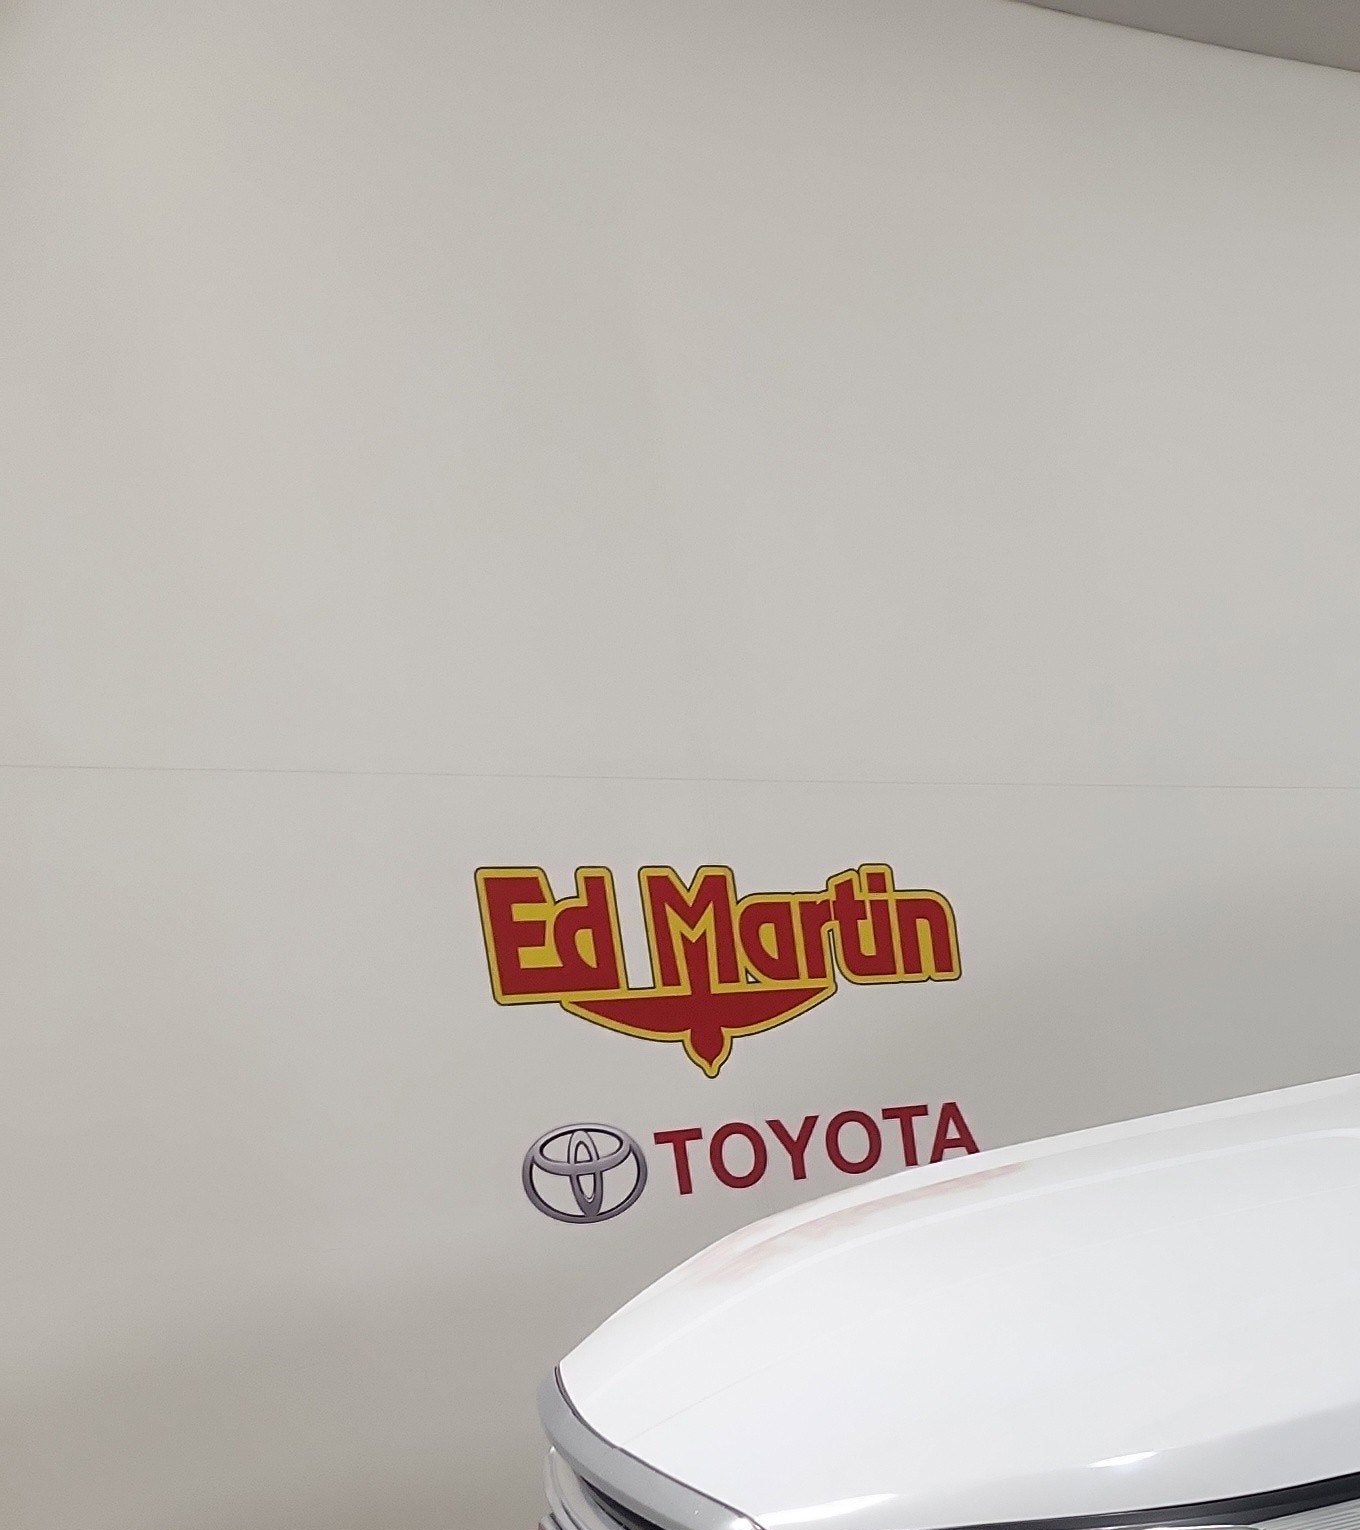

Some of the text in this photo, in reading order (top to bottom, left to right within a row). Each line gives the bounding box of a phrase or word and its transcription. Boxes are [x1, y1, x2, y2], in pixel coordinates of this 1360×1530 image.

[476, 864, 961, 1004] Ed Martin
[654, 1102, 980, 1195] TOYOTA
